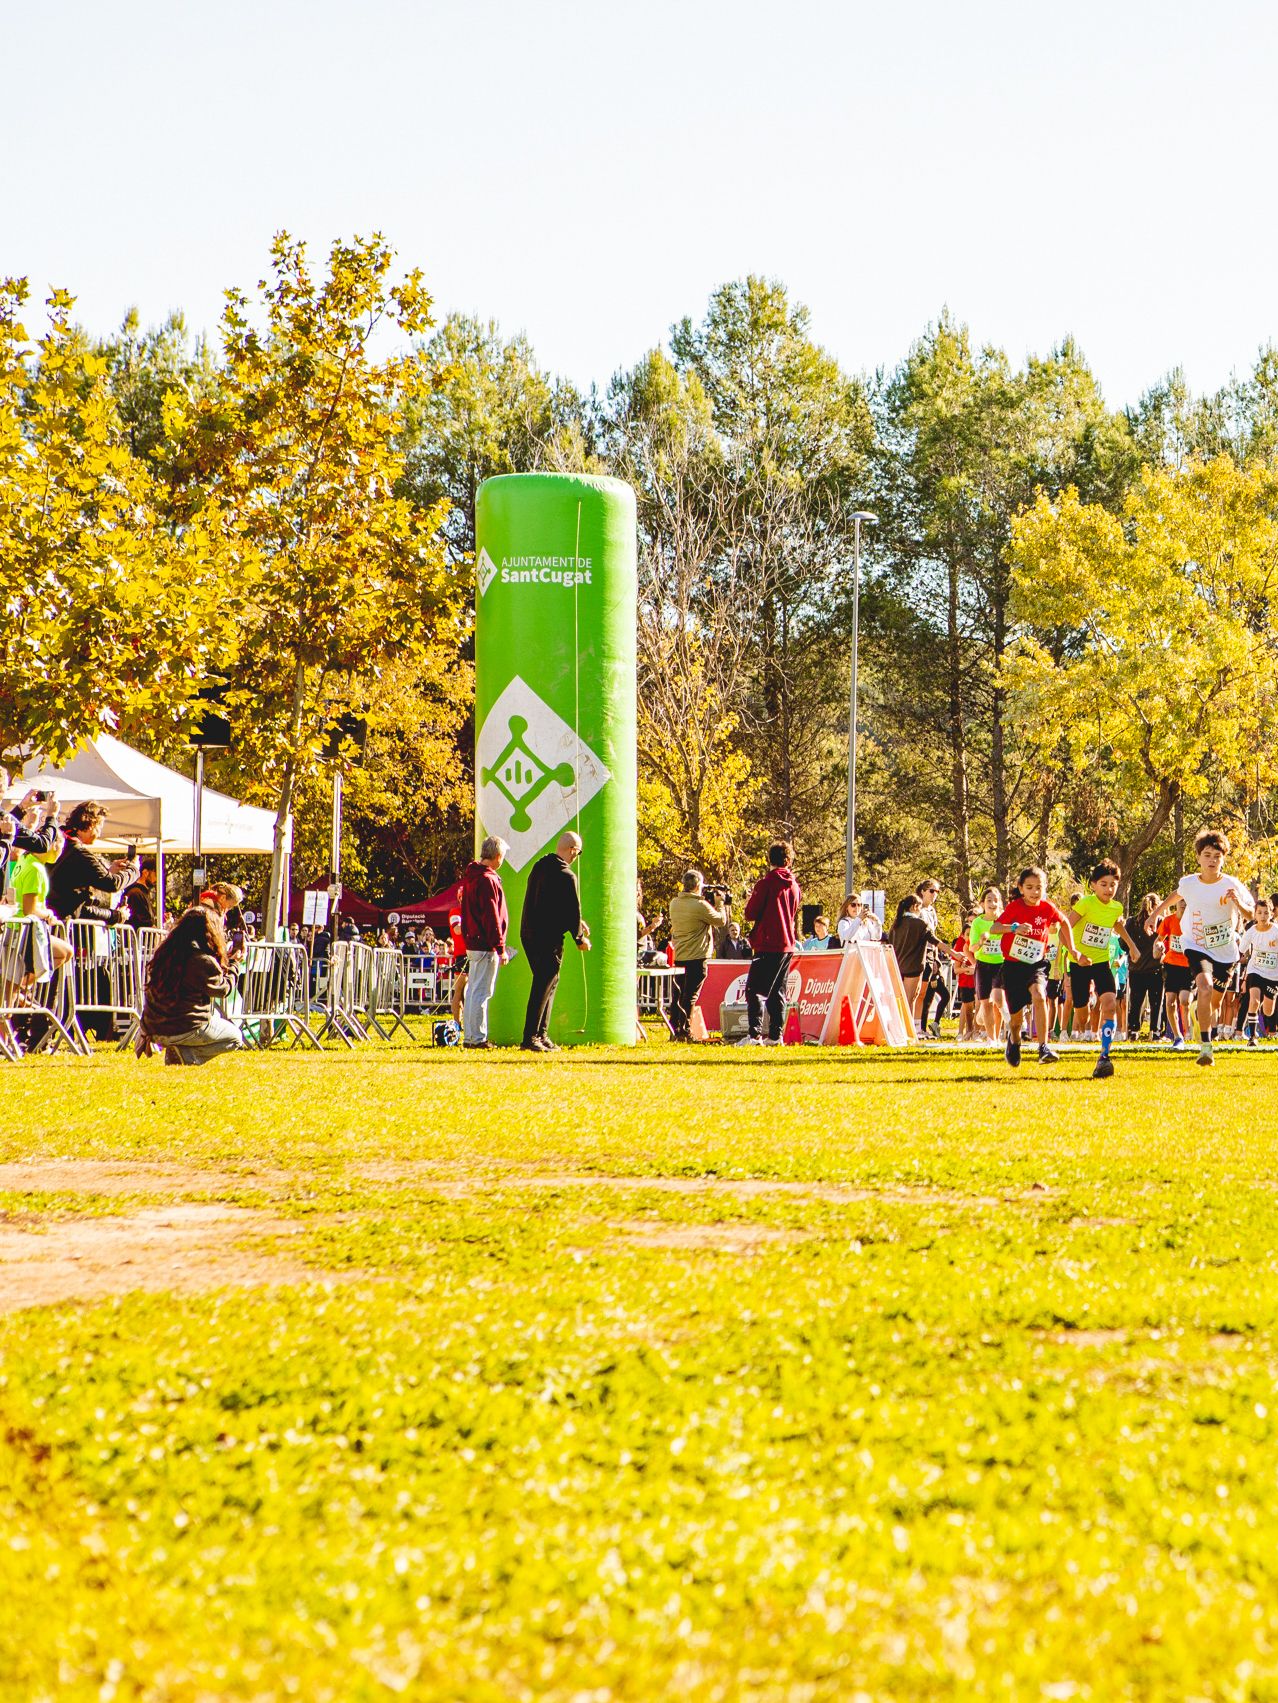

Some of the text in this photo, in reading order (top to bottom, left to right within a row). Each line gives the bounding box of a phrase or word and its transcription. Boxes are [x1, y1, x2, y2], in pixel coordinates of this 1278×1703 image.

[502, 556, 592, 569] AJUNTAMENT DE
[501, 568, 593, 588] SantCugat
